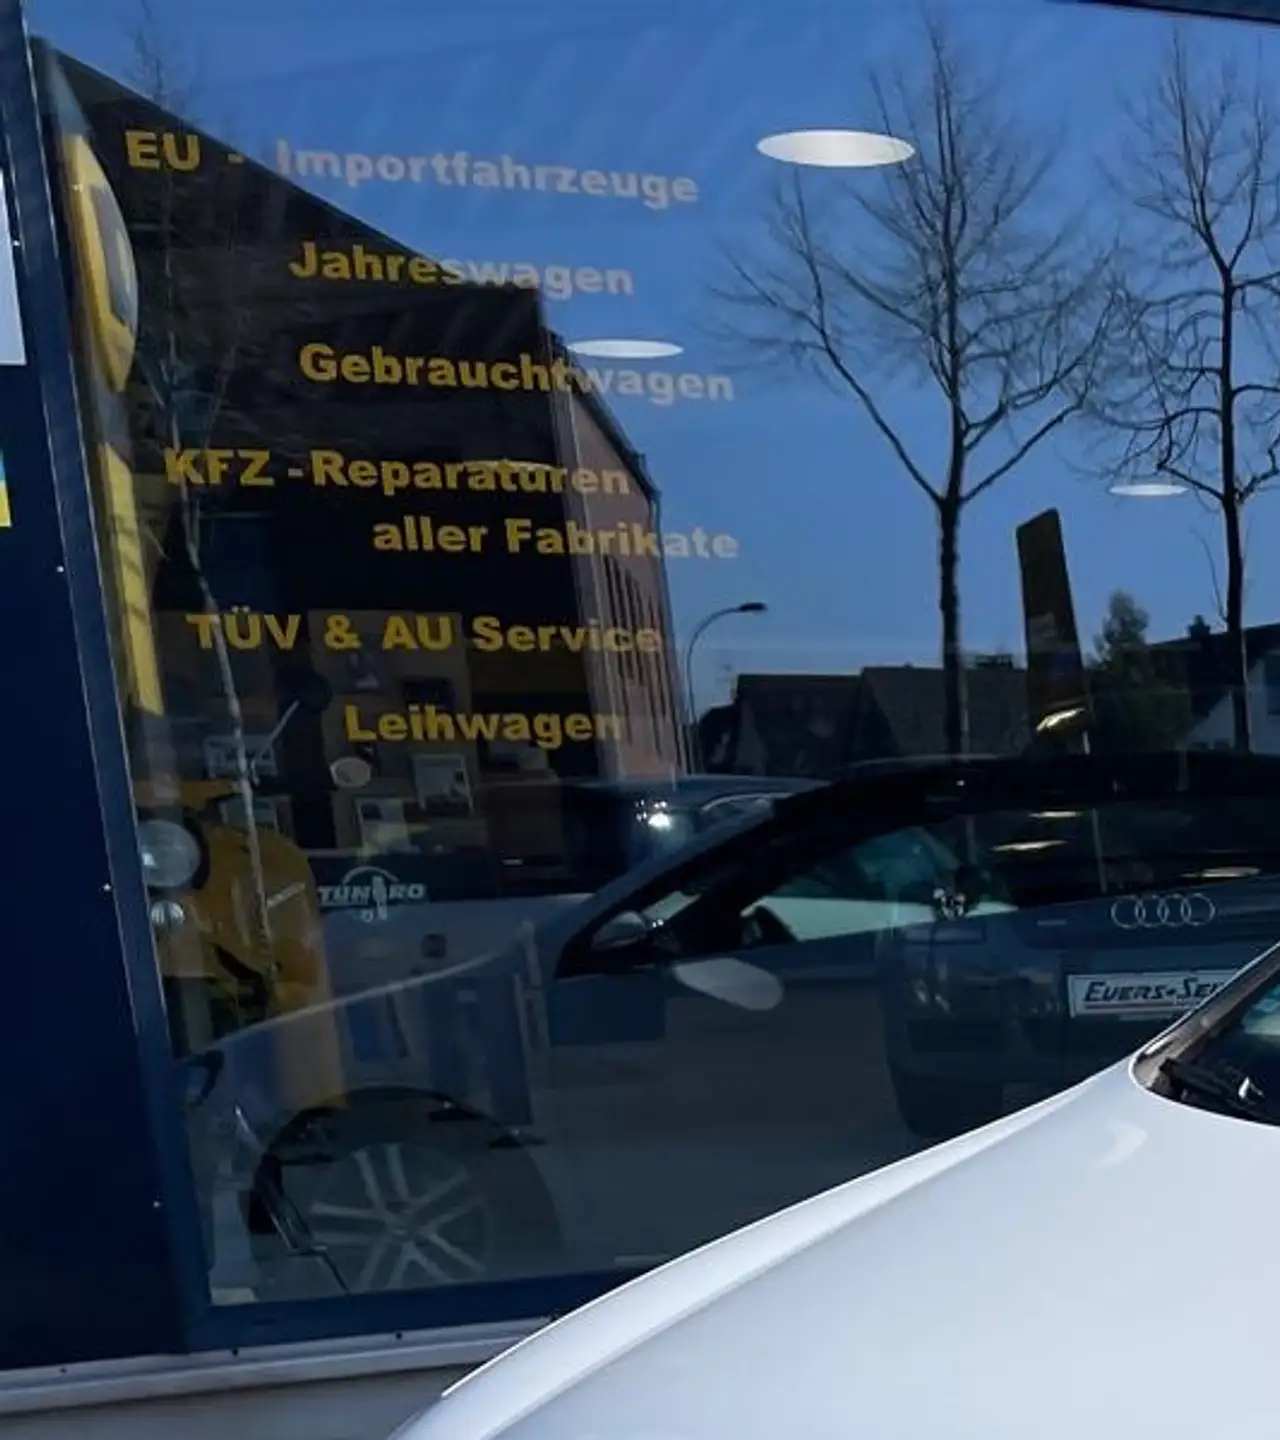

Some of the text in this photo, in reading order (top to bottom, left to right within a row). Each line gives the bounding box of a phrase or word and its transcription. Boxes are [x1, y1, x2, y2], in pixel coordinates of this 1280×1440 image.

[124, 130, 200, 171] EU
[276, 138, 698, 210] Importfahrzeuge
[289, 240, 634, 300] Jahreswagen
[301, 343, 733, 406] Gebrauchtwagen
[164, 448, 275, 487] KFZ
[373, 515, 740, 559] aller Fabrikate
[186, 605, 663, 652] TÜV & AU Service
[345, 704, 625, 748] Leihwagen
